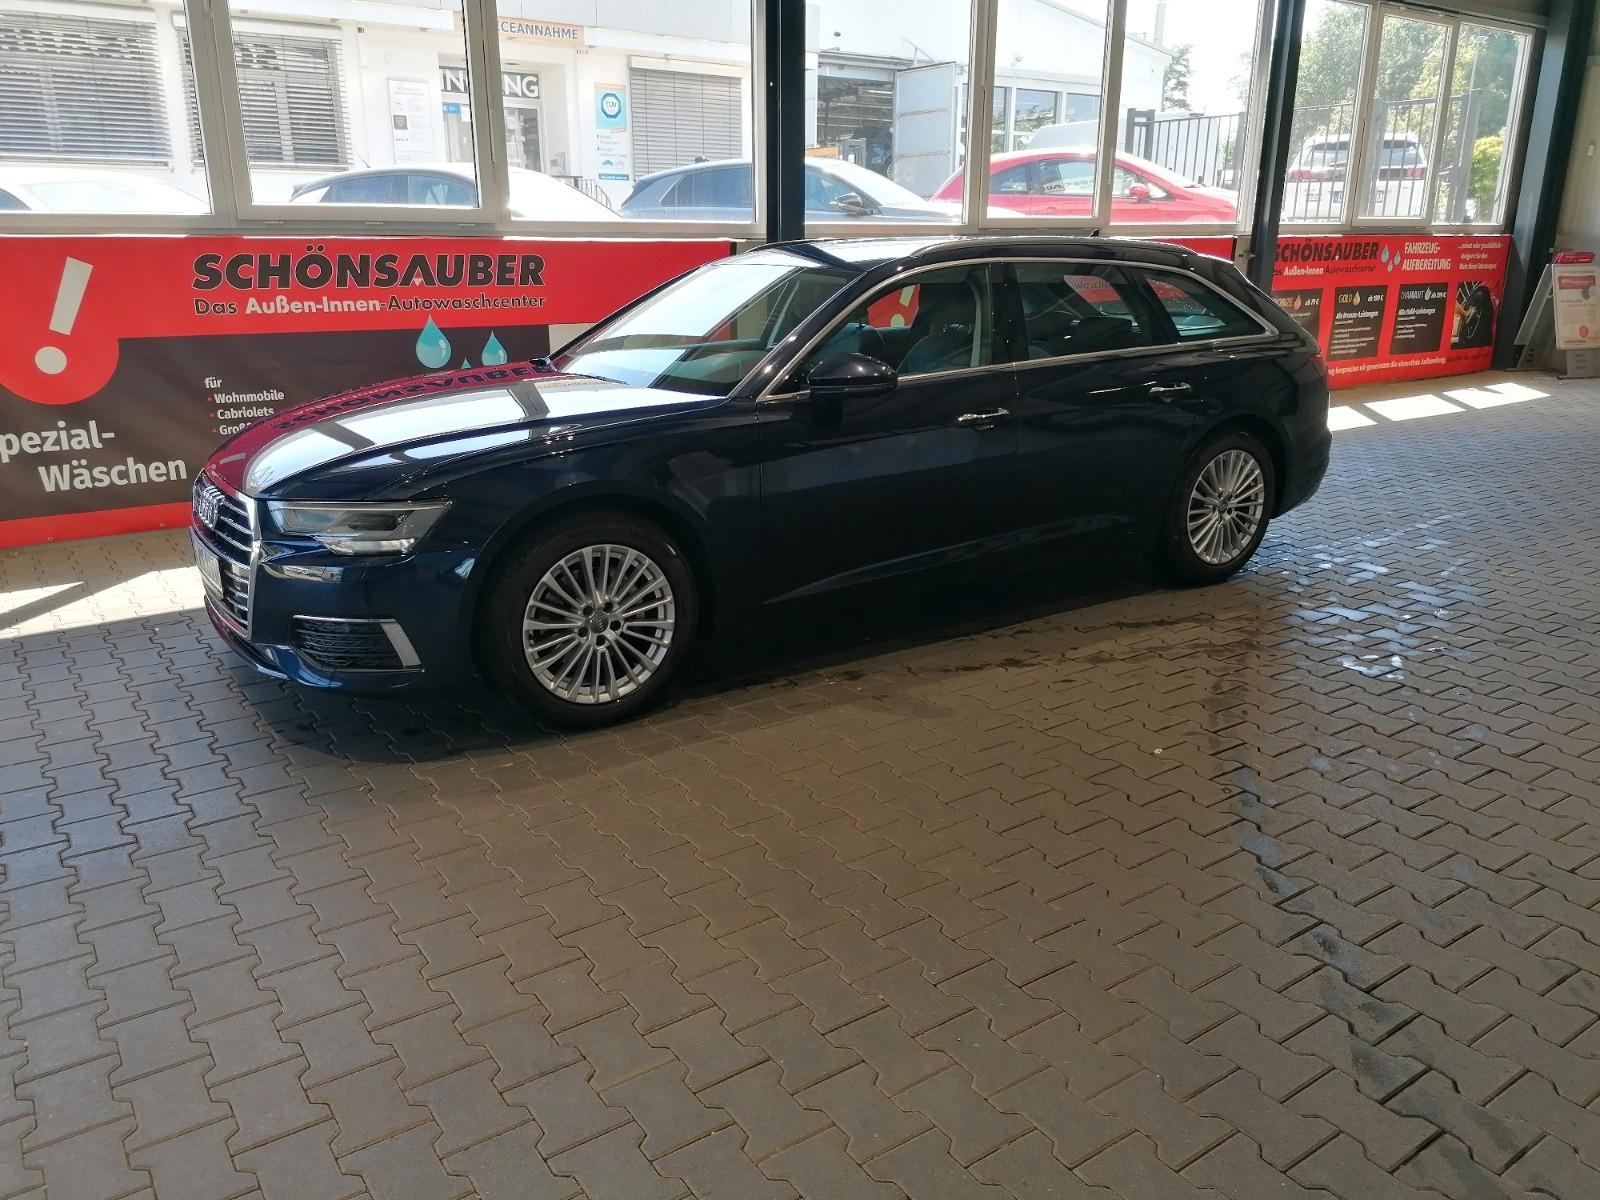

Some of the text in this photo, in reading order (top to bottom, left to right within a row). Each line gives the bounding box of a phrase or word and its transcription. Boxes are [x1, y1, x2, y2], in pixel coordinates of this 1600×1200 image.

[497, 20, 579, 40] CEANNAHME
[1404, 241, 1441, 254] FAHRZEUG-
[193, 244, 545, 290] SCHÖNSAUBER
[1402, 258, 1452, 271] AUFBEREITUNG
[194, 297, 238, 315] Das
[1338, 293, 1353, 304] GOLD
[204, 376, 222, 389] für
[214, 389, 285, 404] Wohnmobile
[217, 406, 275, 420] Cabriolets
[0, 420, 116, 463] pezial-
[38, 457, 187, 492] Wäschen
